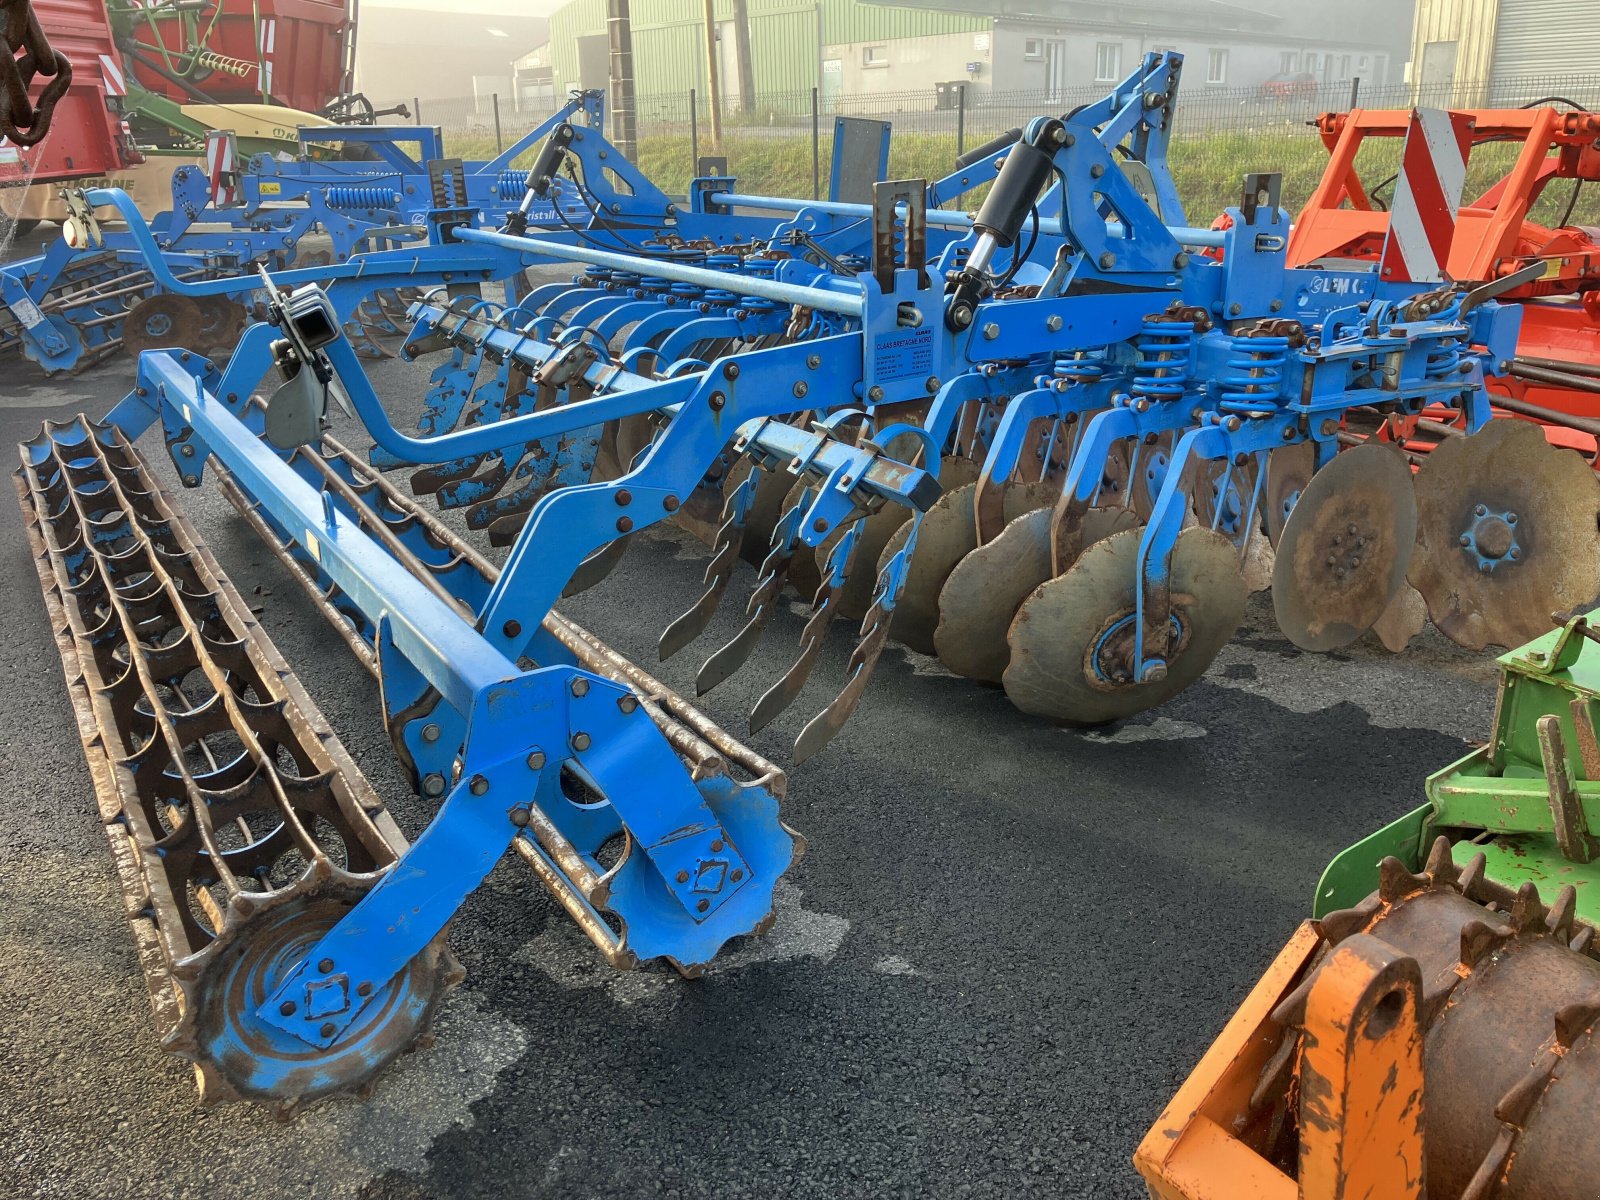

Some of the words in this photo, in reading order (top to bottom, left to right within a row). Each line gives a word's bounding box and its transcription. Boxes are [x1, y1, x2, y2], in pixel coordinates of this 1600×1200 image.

[74, 179, 135, 190] KRONE
[876, 342, 892, 350] CLAAS
[893, 338, 918, 348] BRETAGNE
